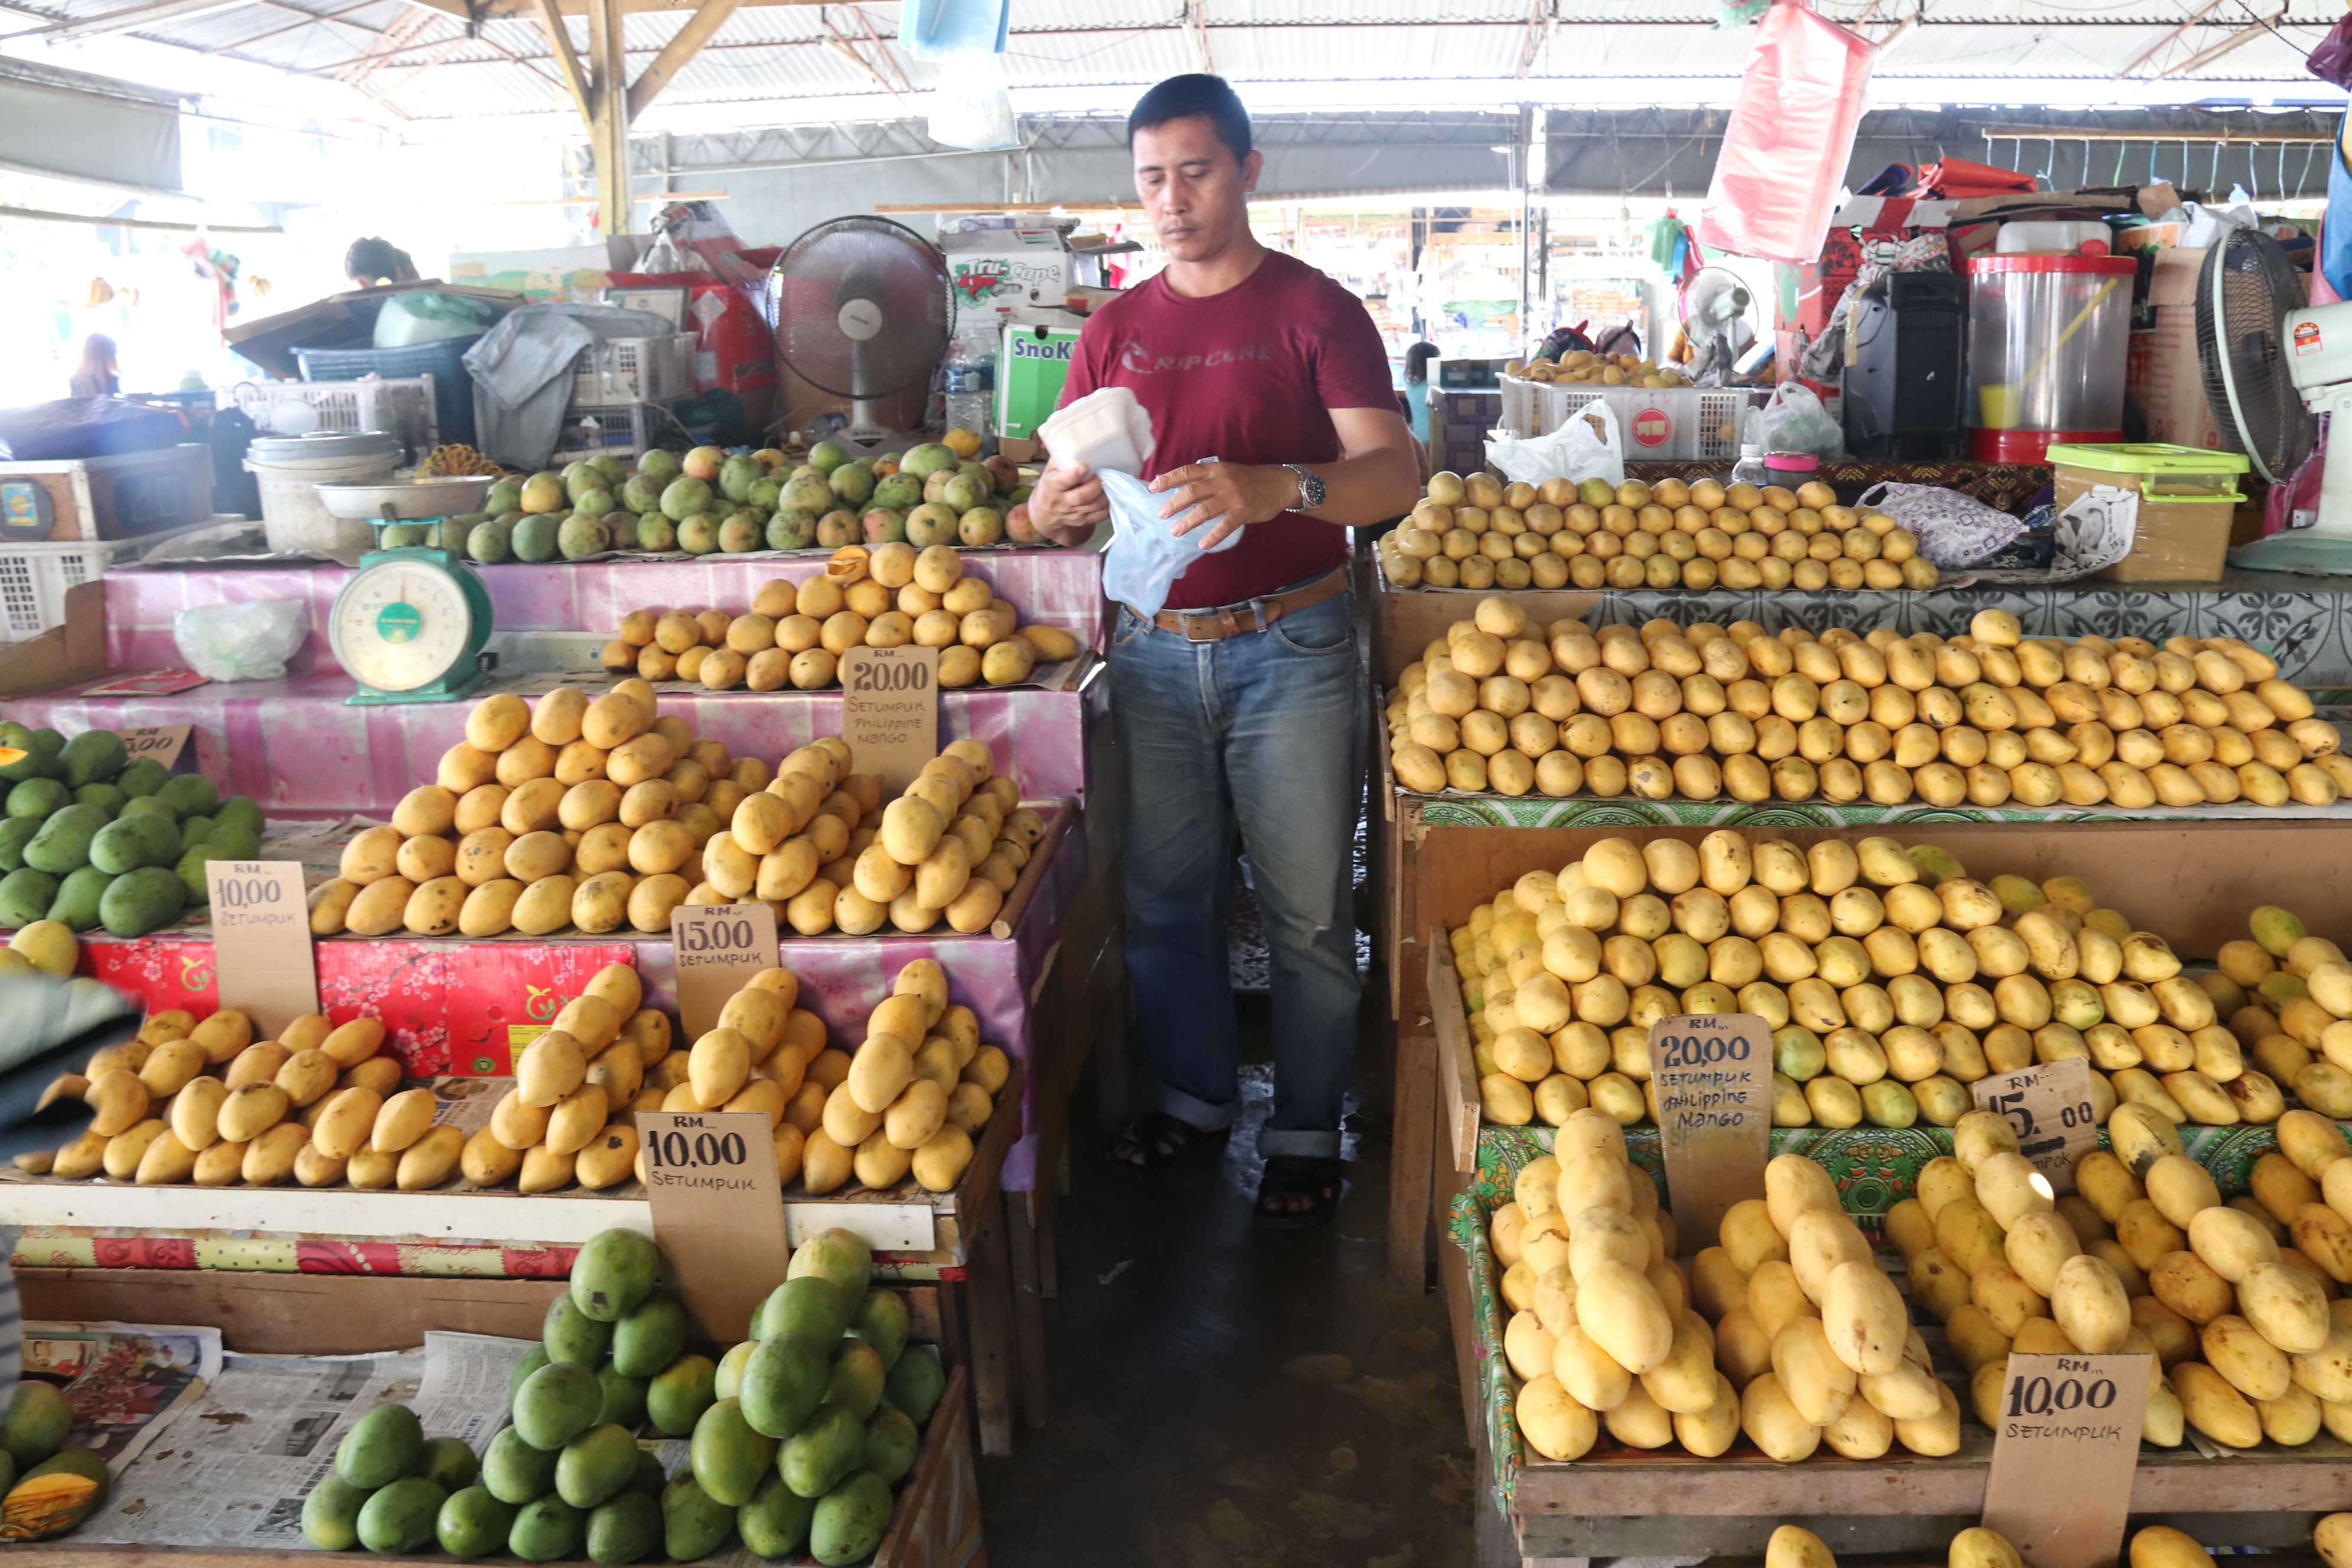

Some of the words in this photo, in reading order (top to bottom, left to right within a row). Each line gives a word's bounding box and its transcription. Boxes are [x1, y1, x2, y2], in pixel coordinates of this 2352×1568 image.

[965, 259, 1061, 287] Tru-Cape
[1014, 337, 1076, 361] SnoK
[848, 696, 925, 713] SETUMPUK
[677, 920, 754, 951] 15.00
[680, 952, 763, 967] SETUMPUK
[1660, 1071, 1752, 1087] SETUMPUK
[652, 1171, 757, 1191] SETUMPUK
[2006, 1423, 2122, 1443] SETUMPUK
